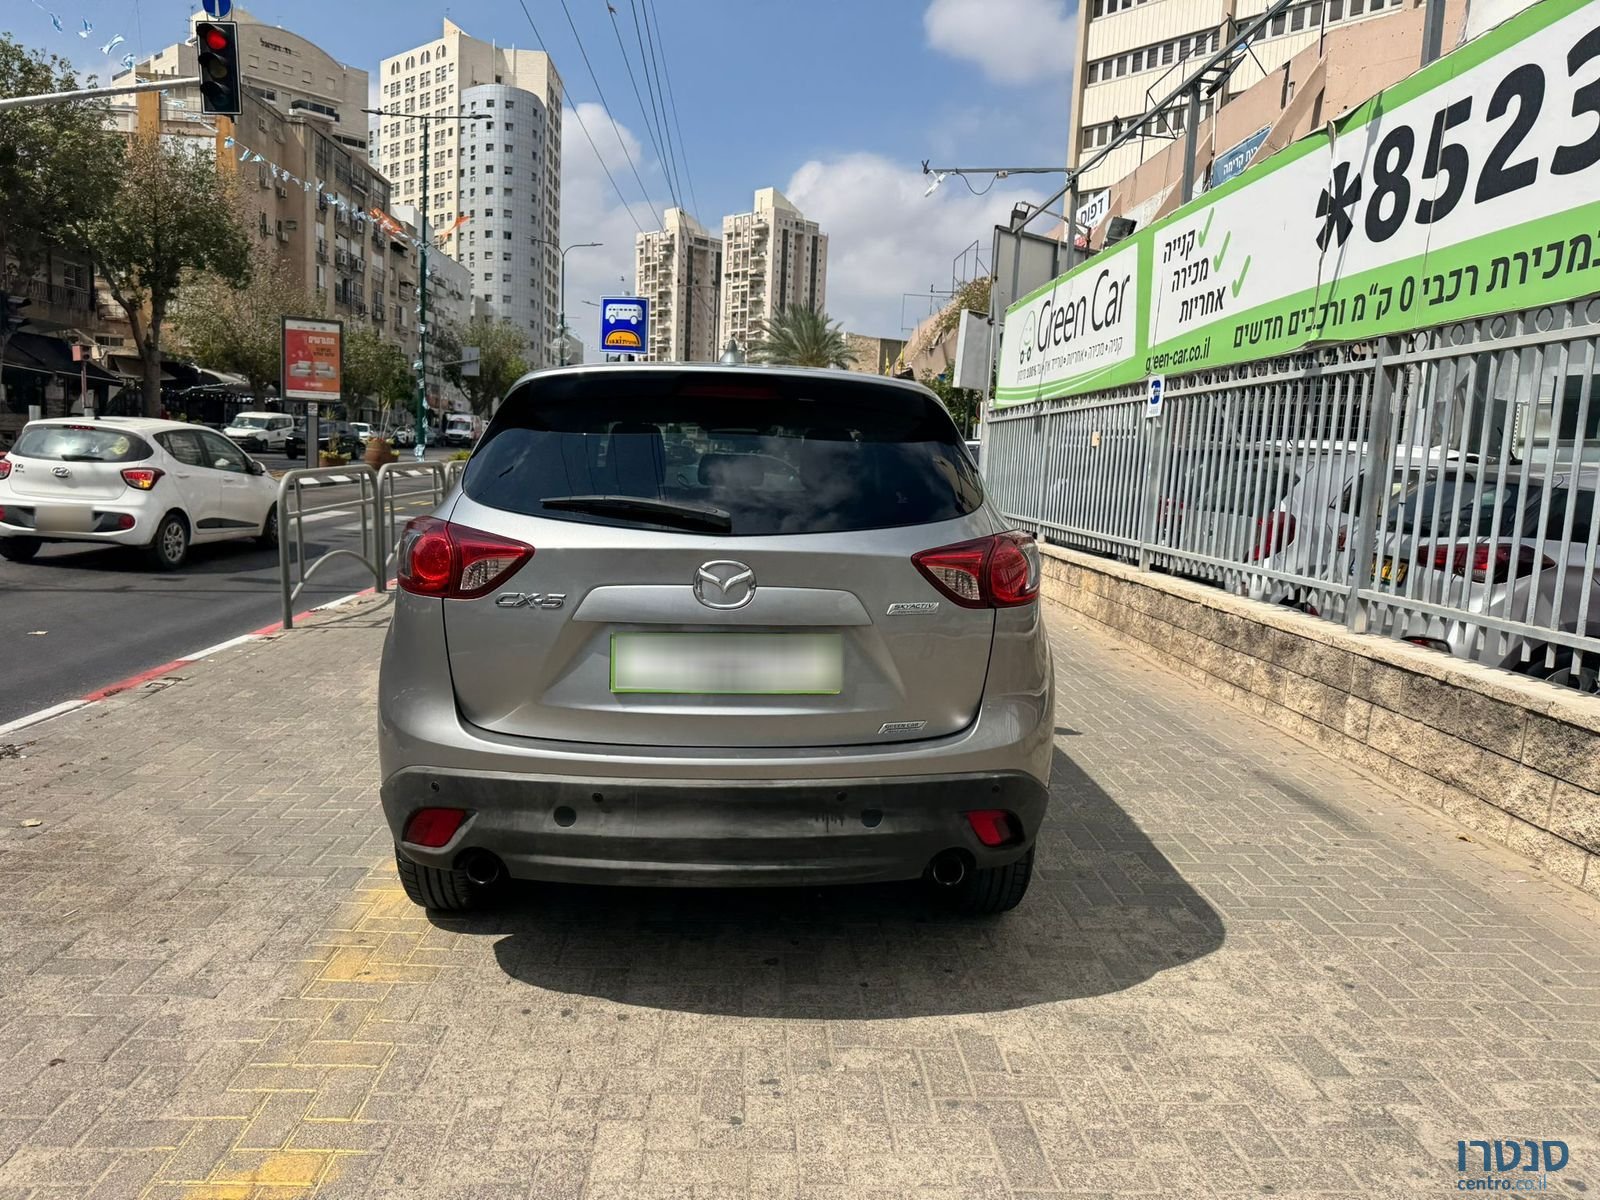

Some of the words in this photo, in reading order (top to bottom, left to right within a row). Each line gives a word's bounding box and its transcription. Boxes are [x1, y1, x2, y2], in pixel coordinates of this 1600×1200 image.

[1223, 153, 1243, 175] קדימה
[1080, 197, 1104, 225] דפוס
[1163, 229, 1195, 263] קנייה
[1171, 257, 1209, 292] מכירה
[1422, 264, 1479, 306] רכבי
[1037, 295, 1087, 352] Green
[1091, 268, 1131, 331] Car
[1178, 286, 1226, 323] אחריות
[1400, 275, 1415, 312] 0
[1233, 315, 1283, 348] חדשים
[1288, 298, 1346, 336] ורכבים
[1145, 336, 1211, 373] geen-car.co.il
[495, 592, 567, 609] CX-5
[894, 602, 935, 610] SKYACTIV
